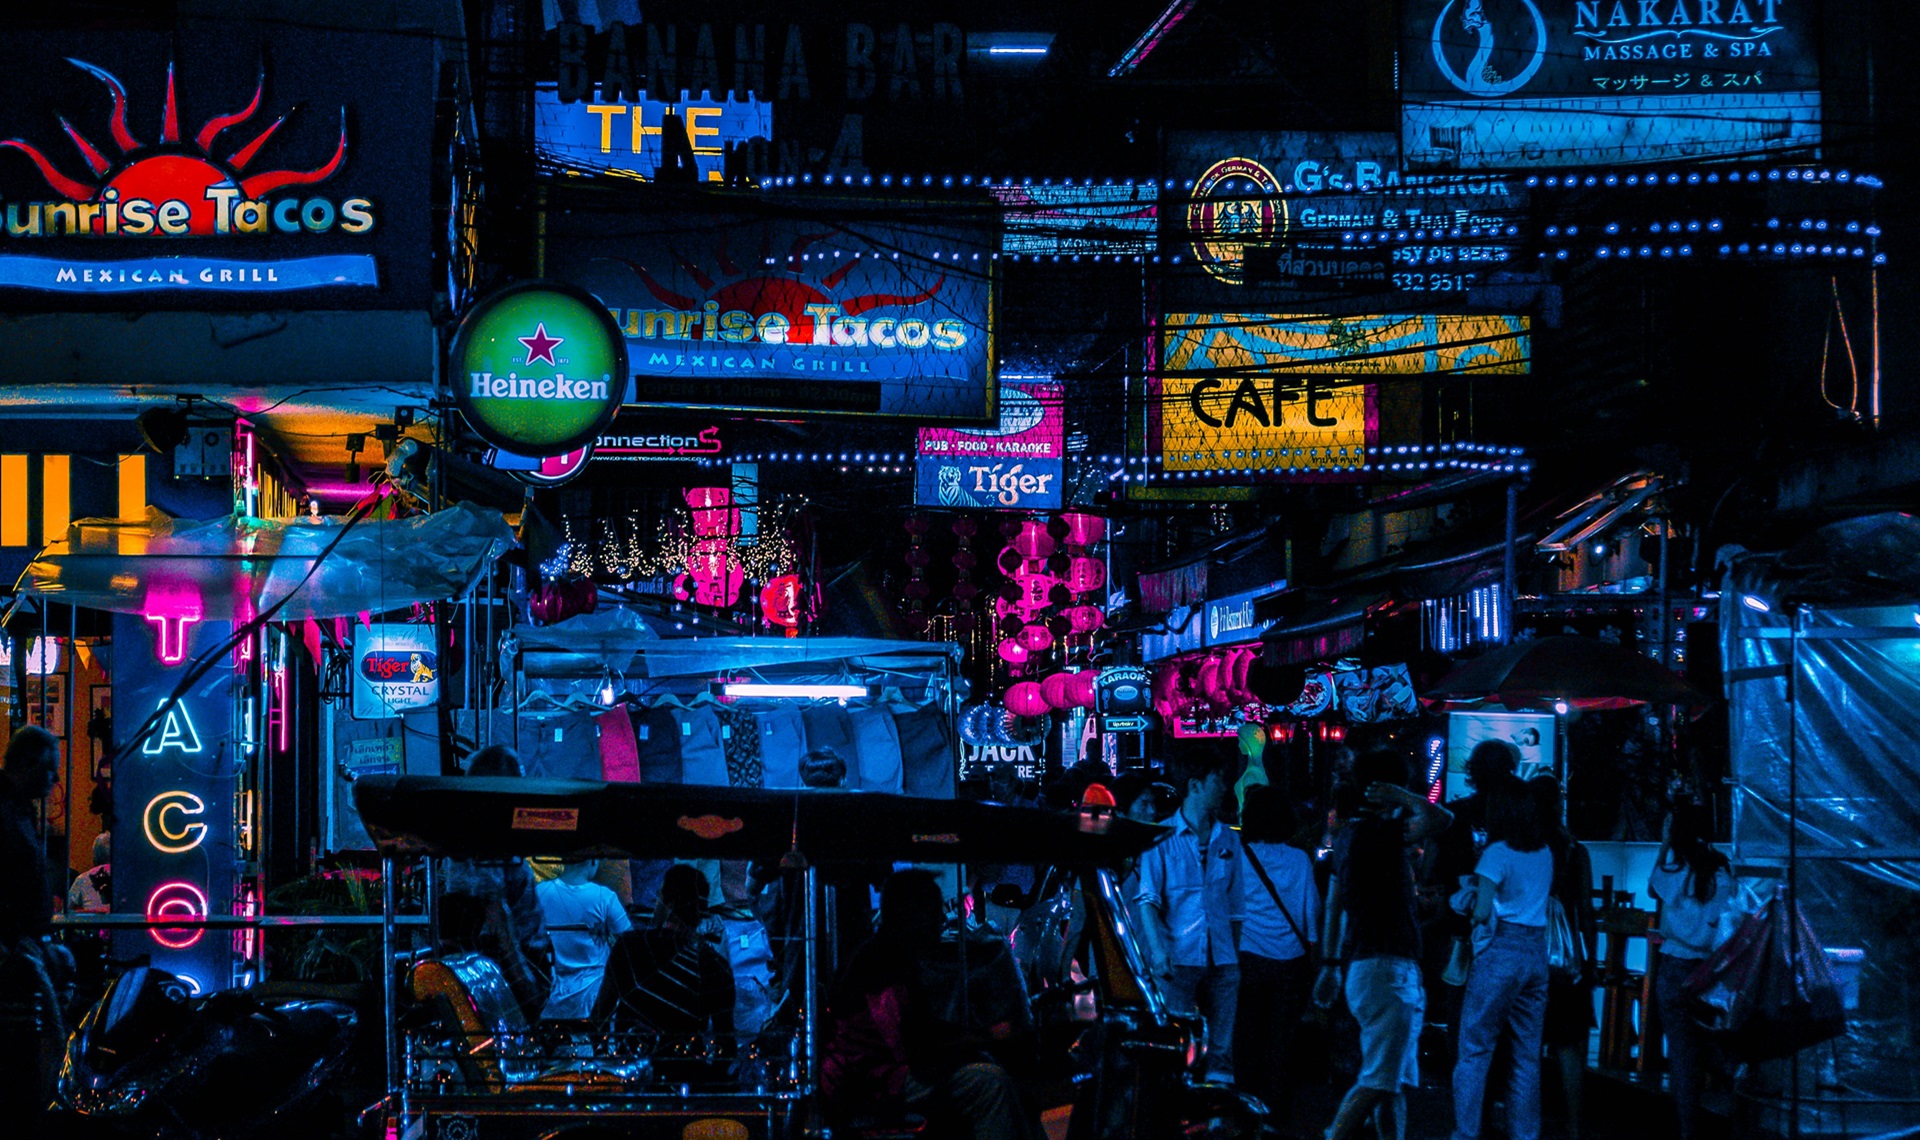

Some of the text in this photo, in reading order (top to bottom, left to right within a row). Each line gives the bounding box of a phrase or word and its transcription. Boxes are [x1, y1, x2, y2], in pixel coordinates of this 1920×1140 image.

[1575, 0, 1783, 28] NAKARAT
[845, 22, 965, 100] BAR
[1584, 42, 1773, 61] MASSAGE & SPA
[1592, 72, 1691, 90] マッサージ
[1722, 70, 1764, 87] スパ
[587, 104, 723, 155] THE
[0, 186, 374, 236] unrise Tacos
[56, 266, 278, 283] MEXICAN GRILL
[608, 301, 968, 350] unrise Tacos
[648, 352, 870, 374] MEXICAN GRILL
[470, 372, 609, 400] Heineken
[1190, 379, 1338, 428] CAFE
[925, 440, 1052, 454] PUB FOOD KARAOKE
[968, 463, 1053, 506] Tiger
[365, 657, 410, 679] Tiger
[371, 686, 429, 696] CRYSTAL
